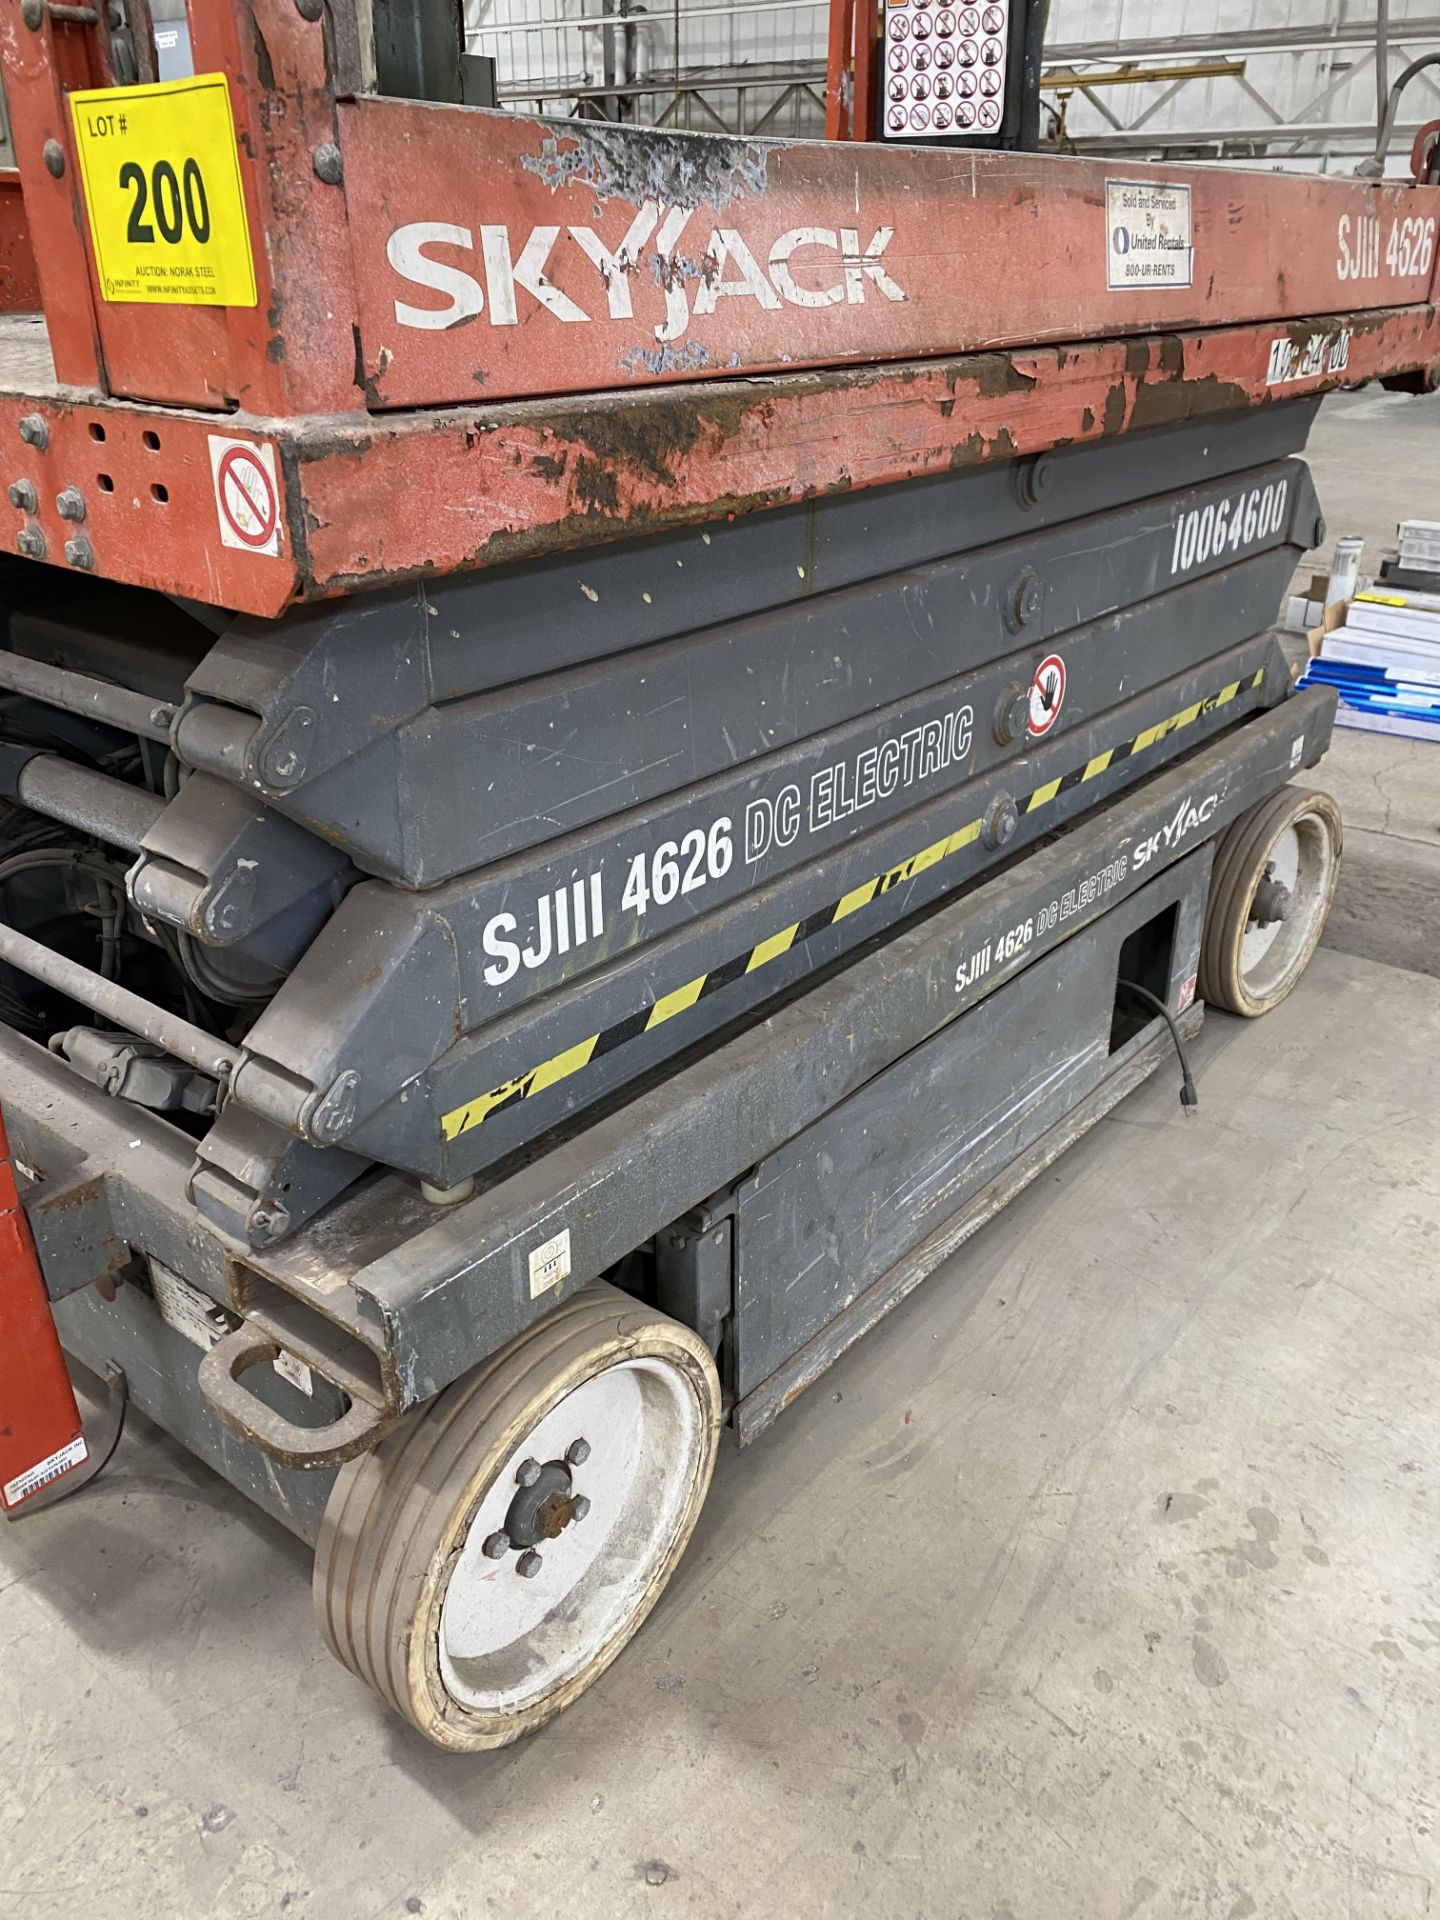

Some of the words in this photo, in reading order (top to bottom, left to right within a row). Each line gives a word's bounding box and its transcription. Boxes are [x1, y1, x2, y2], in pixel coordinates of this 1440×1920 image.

[87, 115, 115, 137] LOT
[119, 114, 127, 135] #
[119, 157, 211, 244] 200
[1122, 193, 1137, 208] Sold
[1138, 194, 1150, 209] and
[1151, 195, 1177, 210] Serviced
[1146, 213, 1155, 229] By
[1131, 234, 1157, 250] United
[1158, 235, 1185, 250] Rentals
[1336, 214, 1381, 281] SJIII
[1385, 216, 1436, 278] 4626
[136, 265, 168, 277] AUCTION:
[170, 266, 195, 277] NORAK
[195, 267, 216, 278] STEEL
[386, 198, 909, 343] SKYJACK
[1125, 264, 1176, 277] 800-UR-RENTS
[1171, 479, 1288, 575] 10064600
[482, 870, 605, 987] SJIII
[620, 816, 734, 917] 4626
[745, 783, 801, 865] DC
[808, 704, 975, 833] ELECTRIC
[954, 942, 992, 993] SJIII
[994, 918, 1034, 963] 4626
[1036, 901, 1059, 937] DC
[1059, 855, 1129, 922] ELECTRIC
